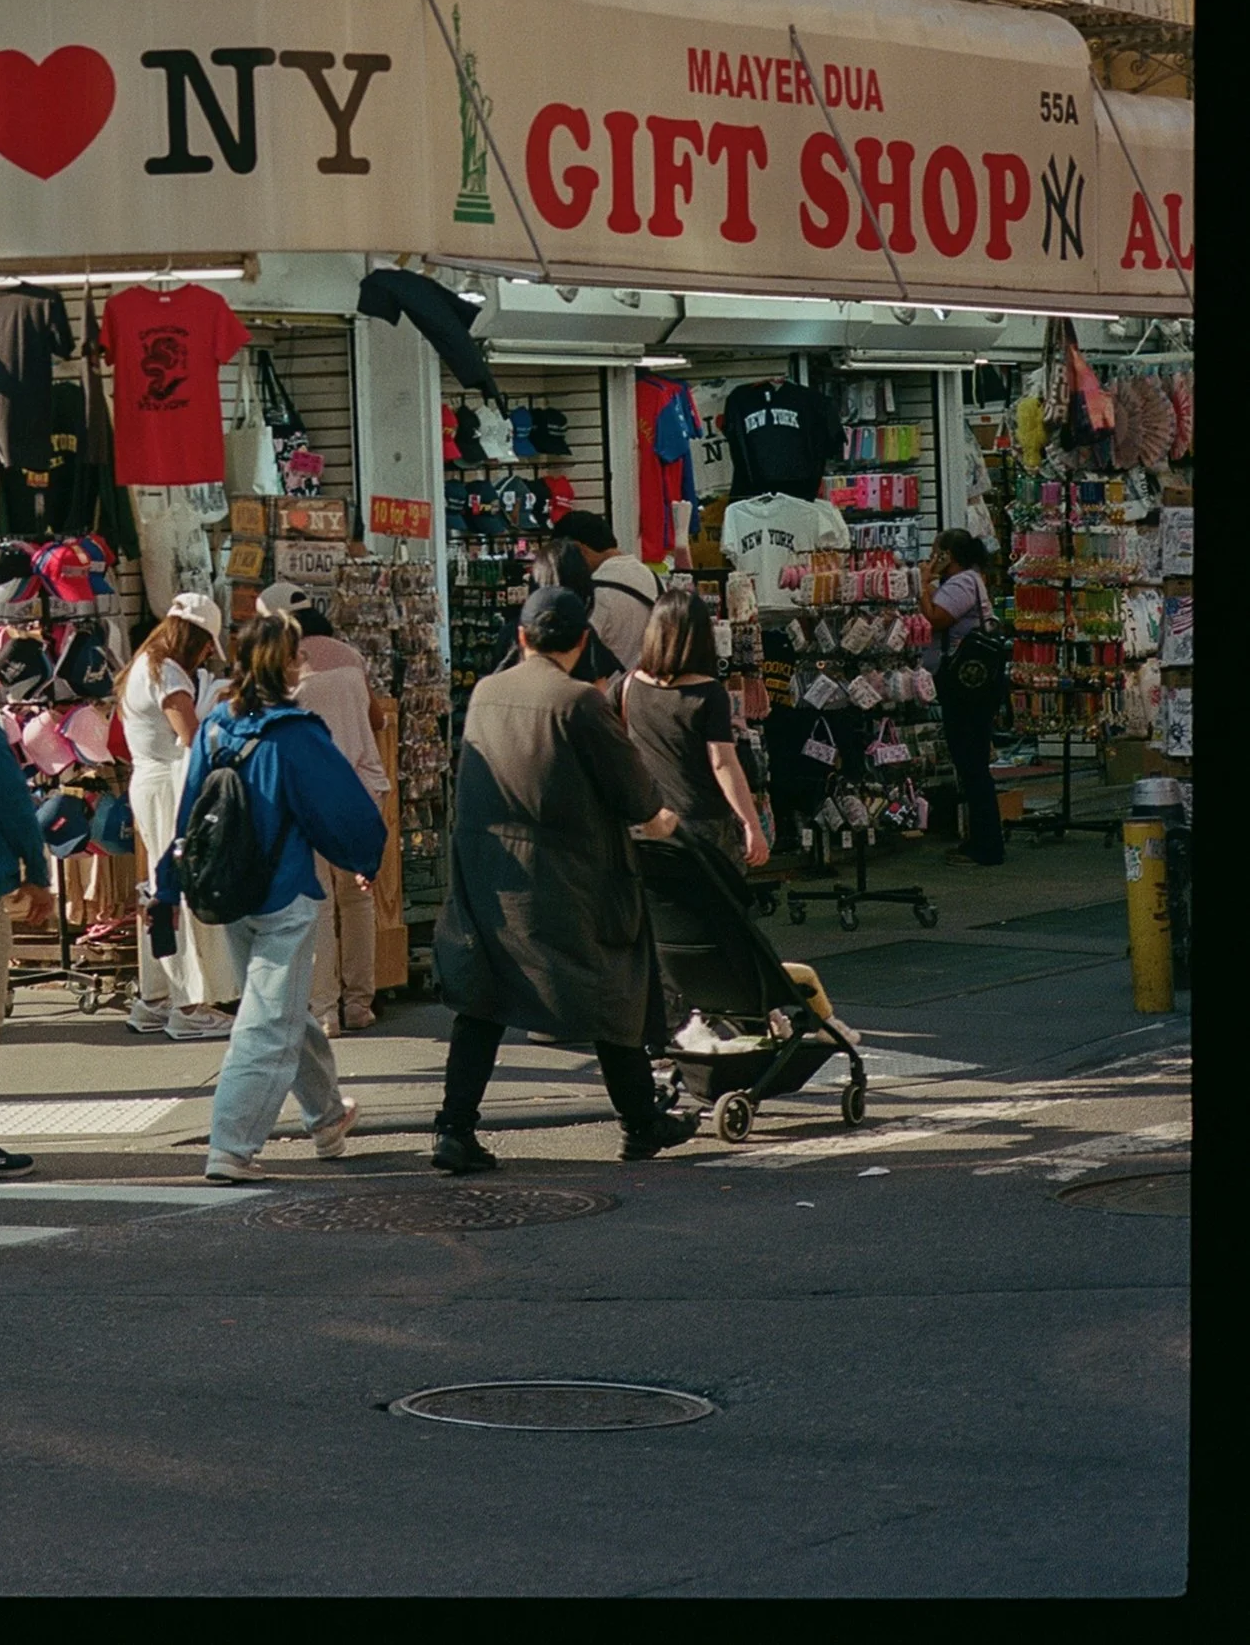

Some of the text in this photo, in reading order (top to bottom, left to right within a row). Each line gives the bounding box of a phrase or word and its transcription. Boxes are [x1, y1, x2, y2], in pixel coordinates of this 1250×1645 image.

[688, 48, 883, 111] MAAYER DUA
[139, 46, 392, 176] NY
[1040, 91, 1080, 125] 55A
[526, 103, 1032, 262] GIFT SHOP
[744, 408, 800, 434] NEW YORK
[703, 442, 723, 465] N
[310, 510, 344, 530] NY
[373, 501, 388, 523] 10
[741, 530, 764, 554] NEW
[767, 529, 796, 551] YORK
